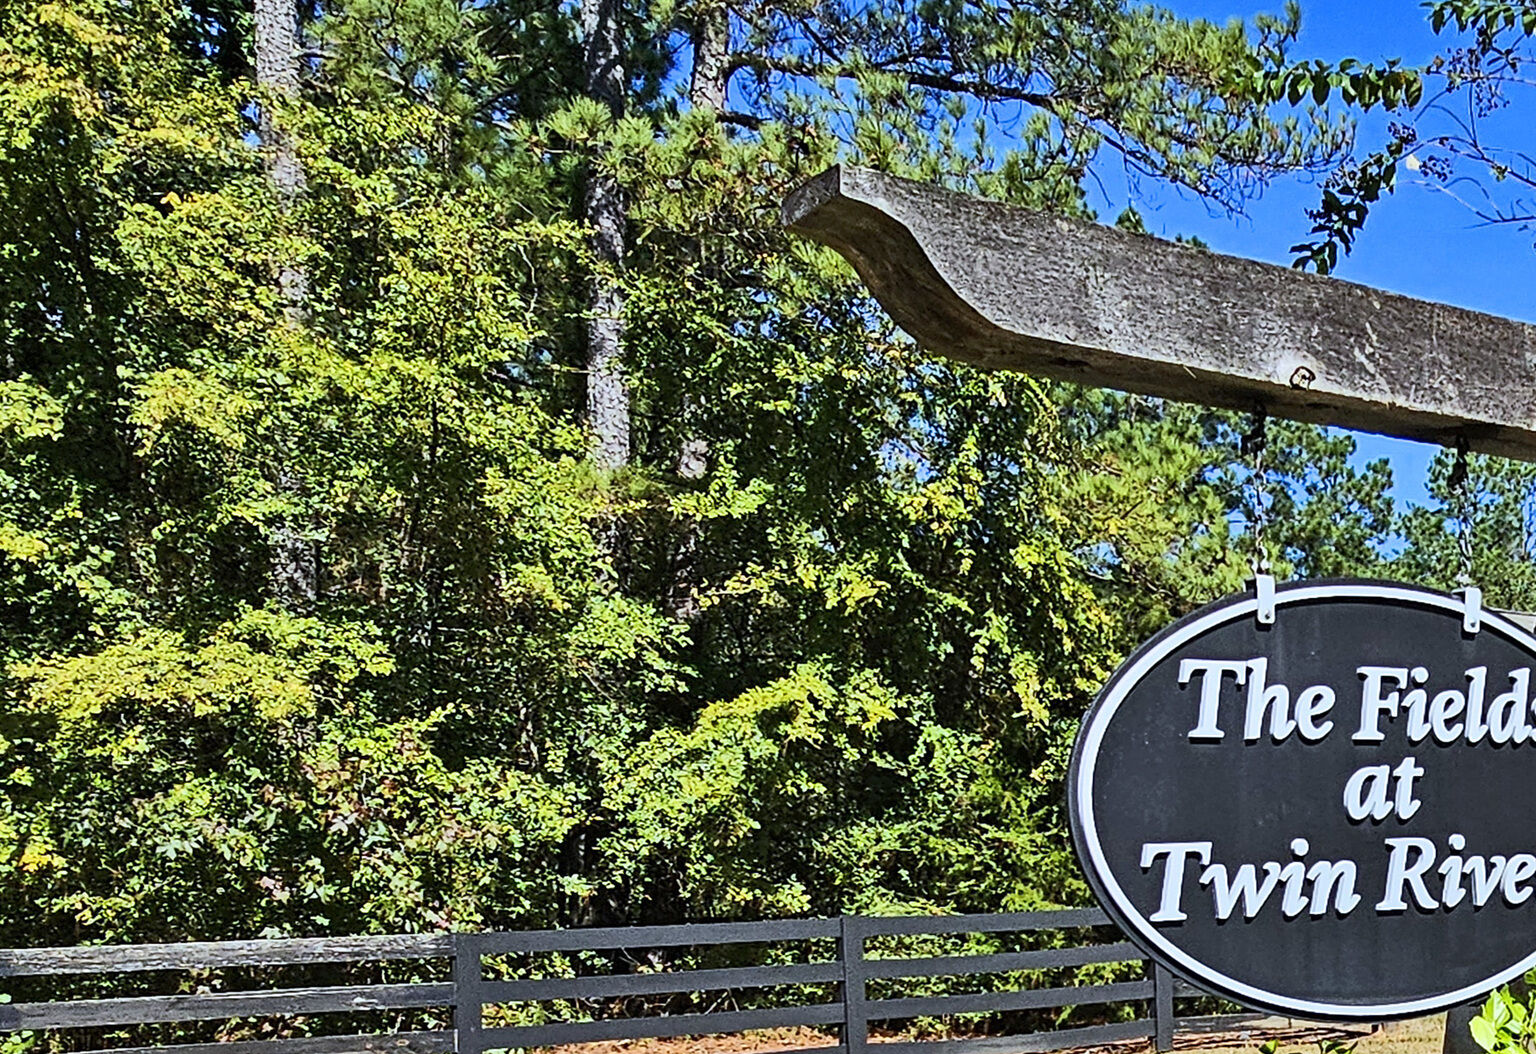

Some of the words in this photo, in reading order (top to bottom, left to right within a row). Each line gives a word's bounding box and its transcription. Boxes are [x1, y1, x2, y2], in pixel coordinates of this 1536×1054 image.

[1178, 657, 1336, 742] The
[1343, 756, 1425, 821] at
[1140, 837, 1361, 922] Twin
